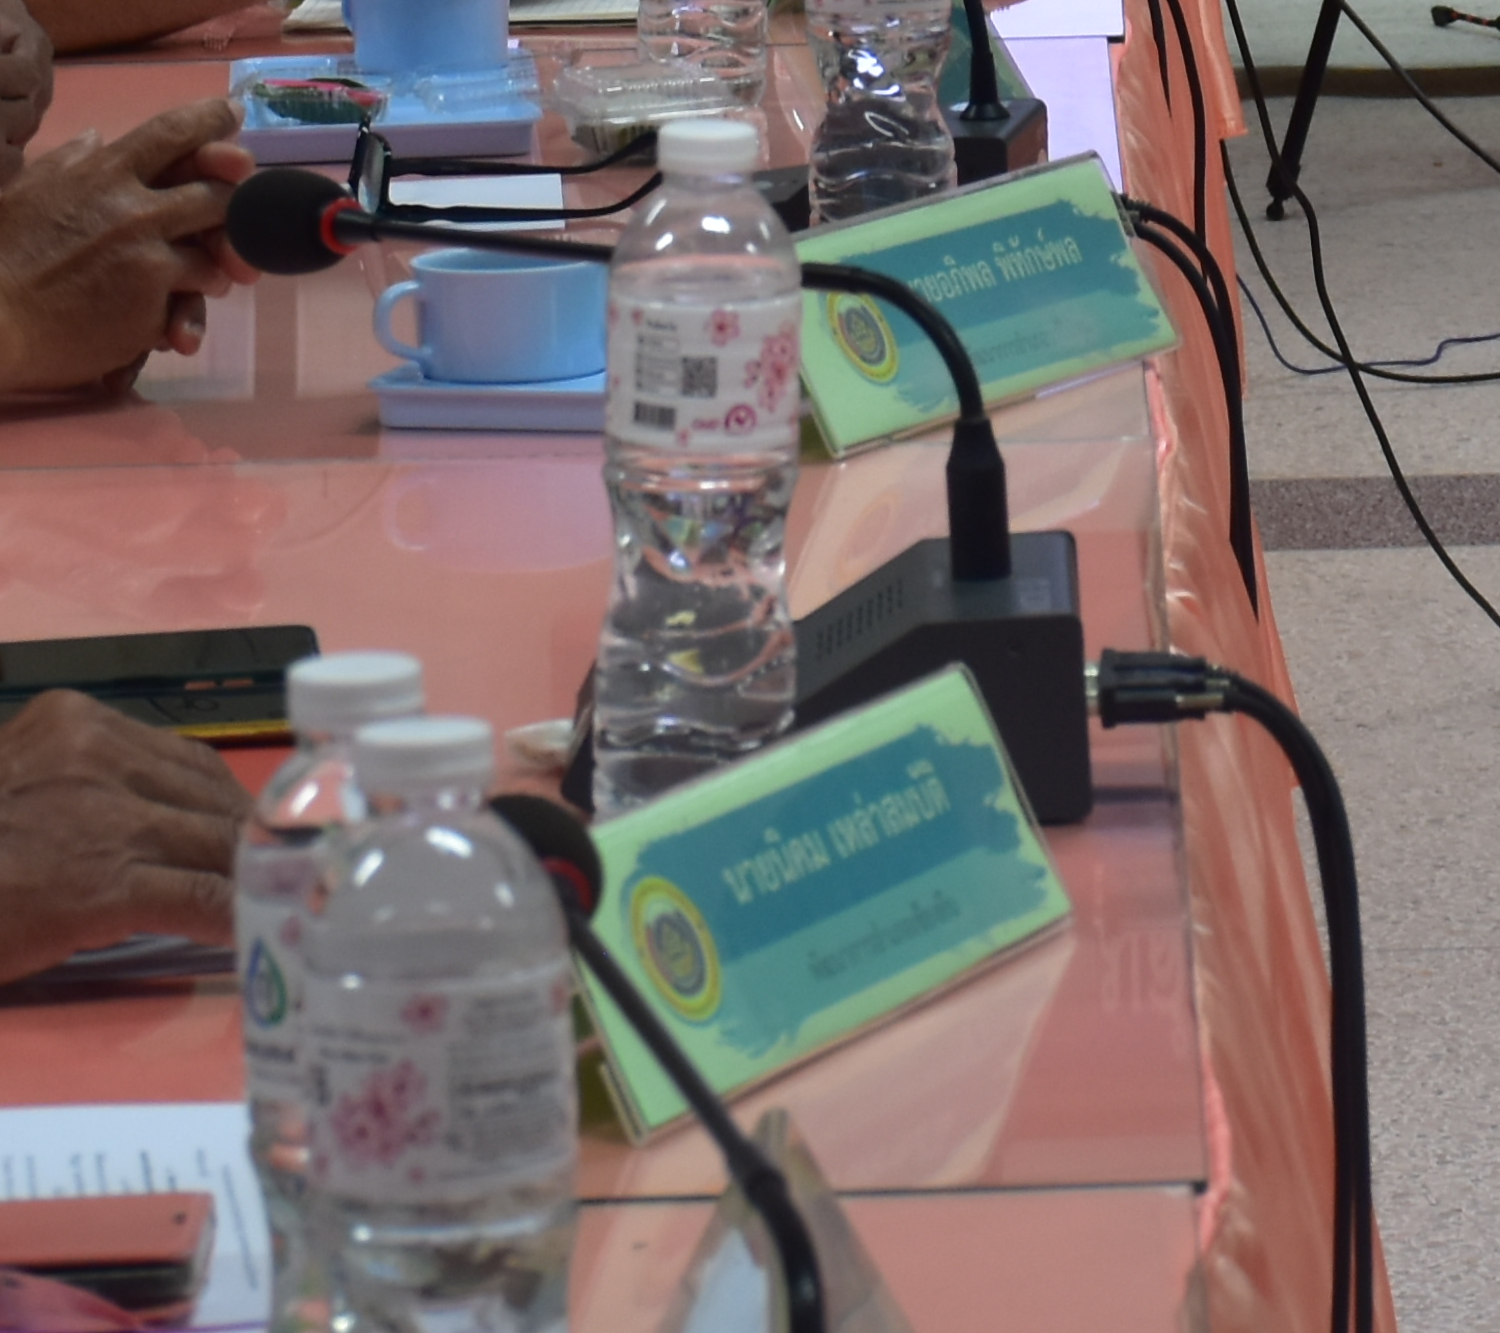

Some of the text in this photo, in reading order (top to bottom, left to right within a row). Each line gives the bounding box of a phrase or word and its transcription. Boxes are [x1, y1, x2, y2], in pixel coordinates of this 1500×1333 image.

[907, 228, 1082, 304] ายอภิพล พิทักษ์พล
[722, 759, 952, 905] นายนิคม เหล่าสมบัติ
